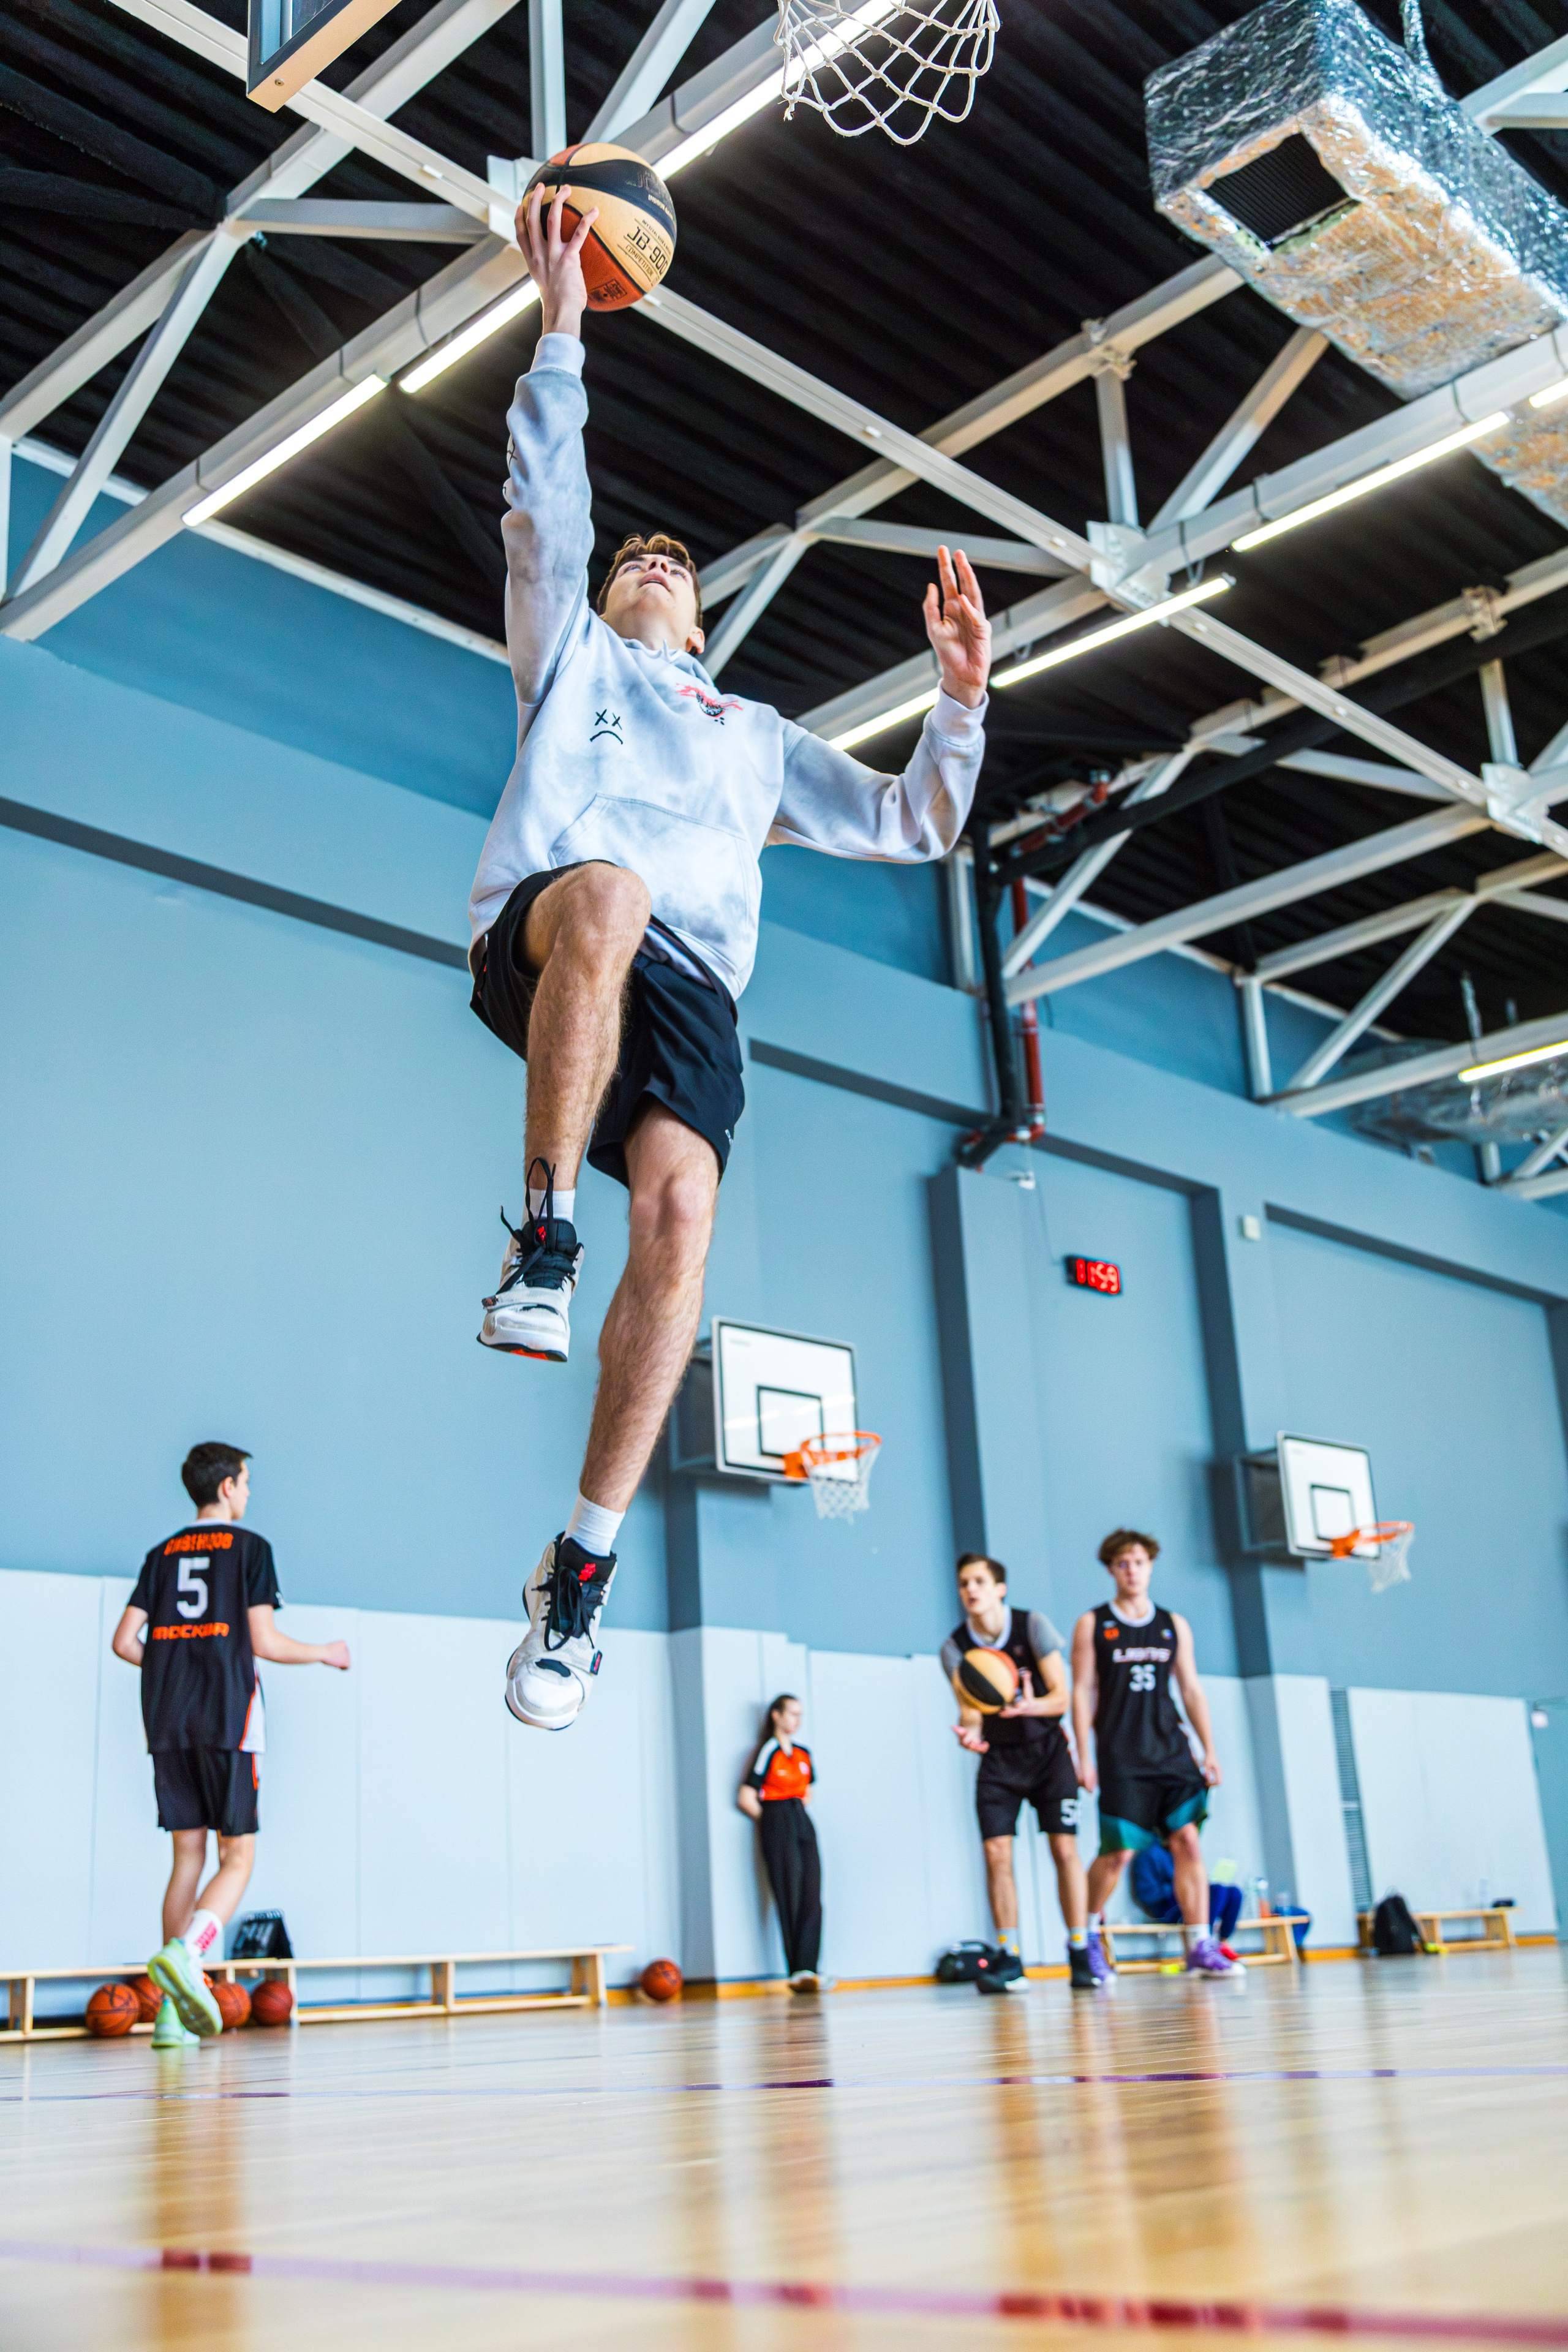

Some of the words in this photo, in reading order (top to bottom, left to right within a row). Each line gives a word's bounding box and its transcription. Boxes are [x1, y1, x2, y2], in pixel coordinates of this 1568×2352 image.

[625, 244, 654, 276] COMPETITION
[627, 225, 668, 275] JB-900
[176, 1556, 210, 1618] 5
